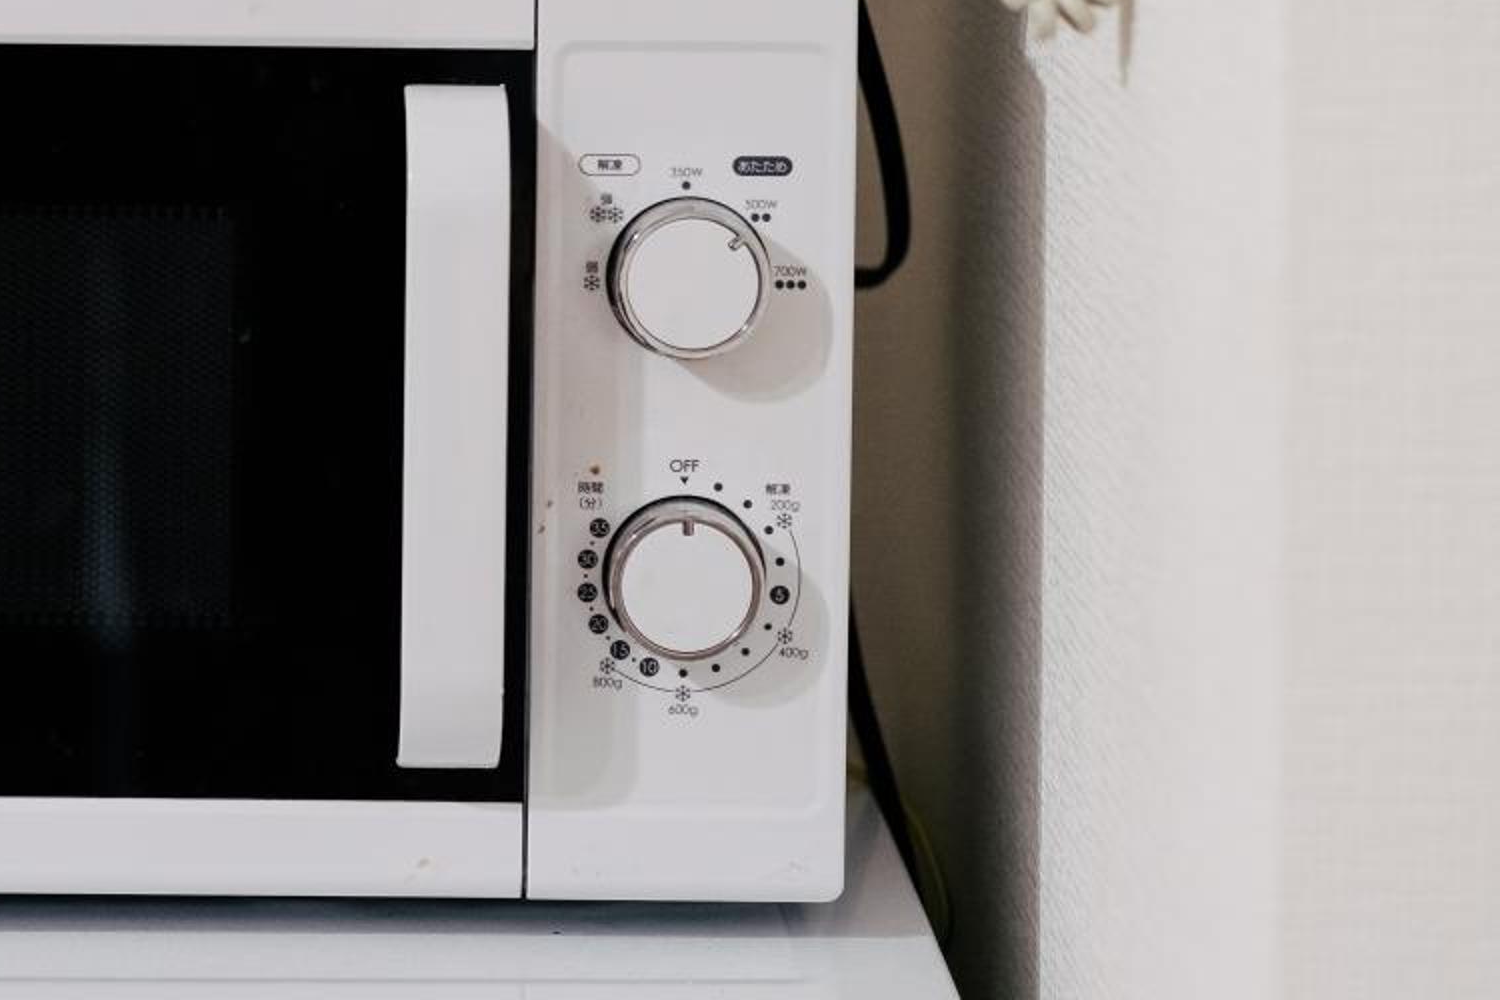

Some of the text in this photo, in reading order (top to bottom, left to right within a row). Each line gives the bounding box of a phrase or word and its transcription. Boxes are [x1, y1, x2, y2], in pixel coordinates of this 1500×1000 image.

[738, 159, 788, 173] あたため
[773, 265, 807, 277] 700W
[669, 459, 700, 473] OFF
[771, 499, 800, 513] 200g
[777, 646, 809, 660] 400g
[592, 676, 623, 690] 800g
[668, 703, 699, 717] 600g
